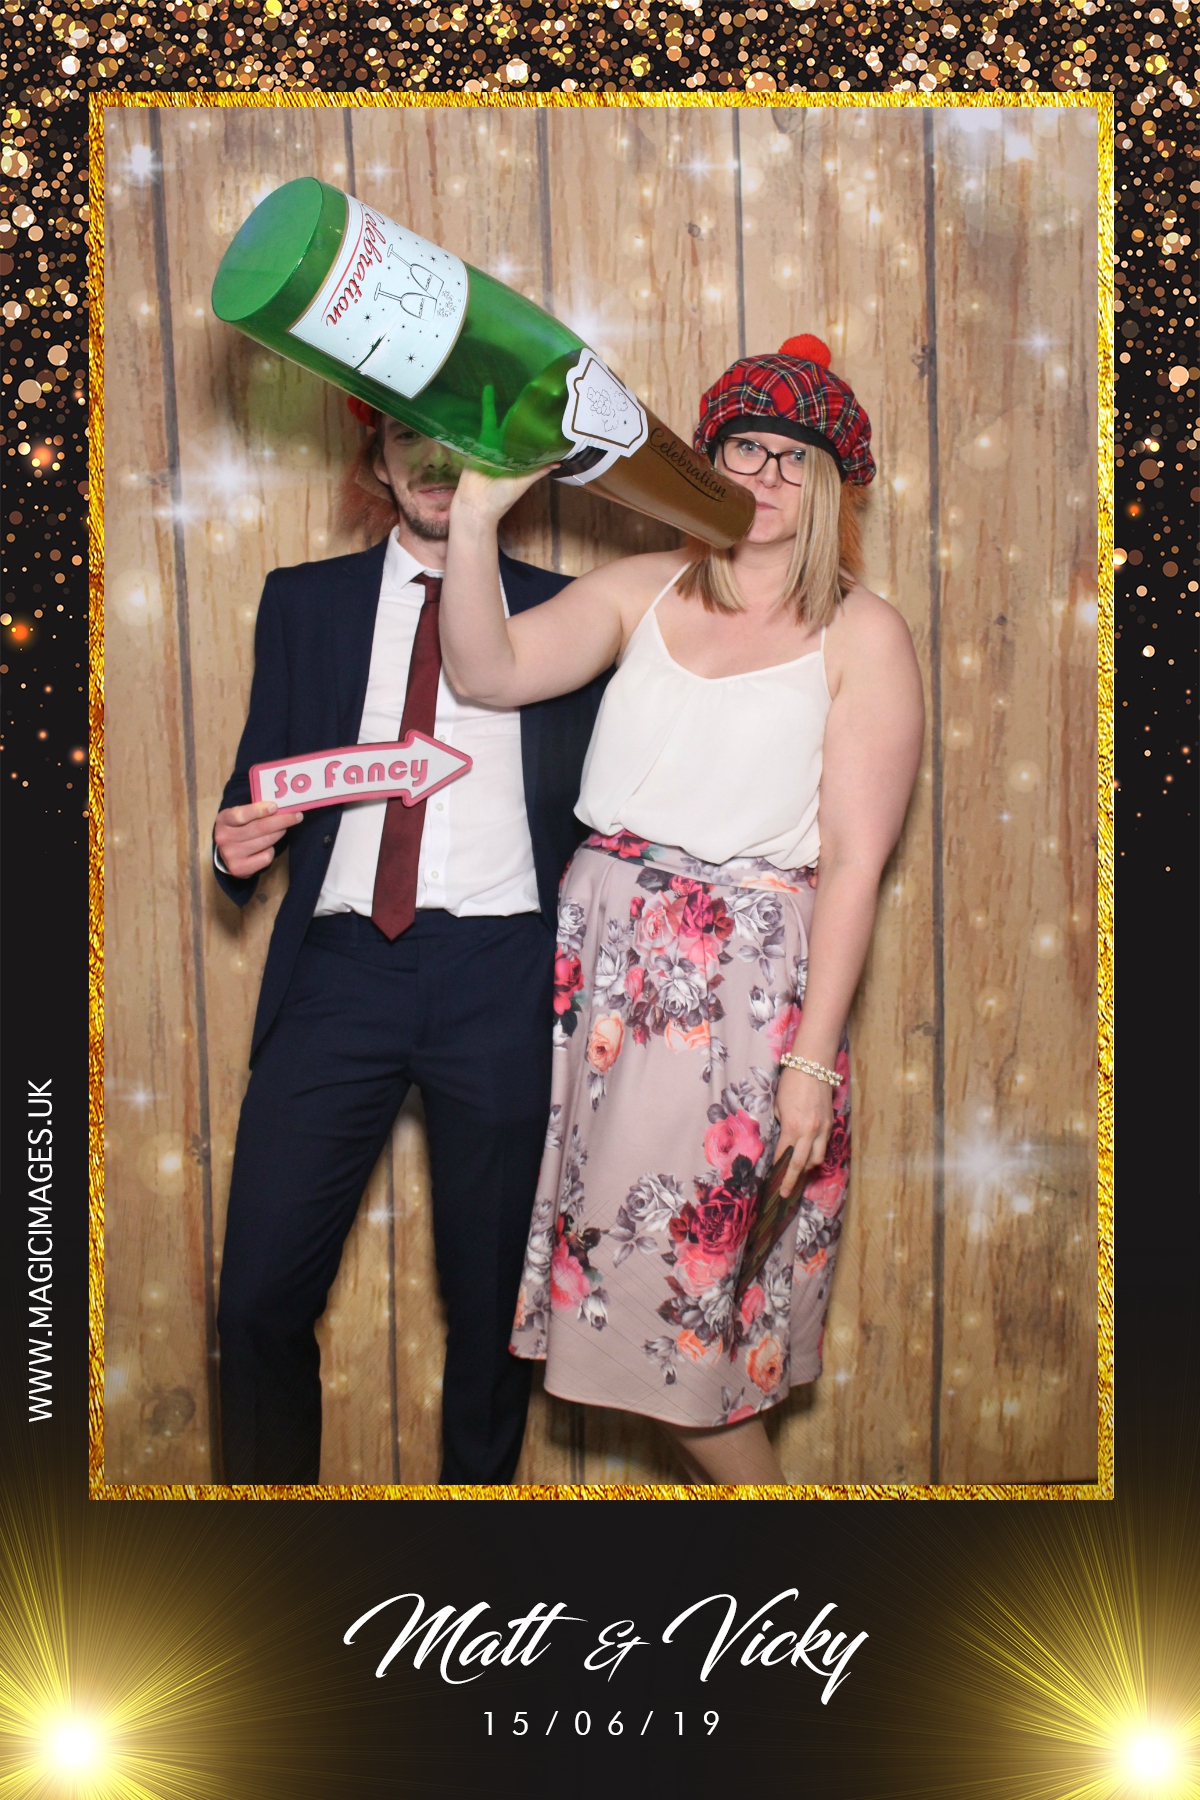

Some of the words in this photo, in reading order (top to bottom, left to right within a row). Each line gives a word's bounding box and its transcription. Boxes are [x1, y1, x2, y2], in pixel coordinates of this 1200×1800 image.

[650, 427, 727, 498] Celebration
[274, 770, 312, 799] So
[324, 759, 428, 788] Fancy
